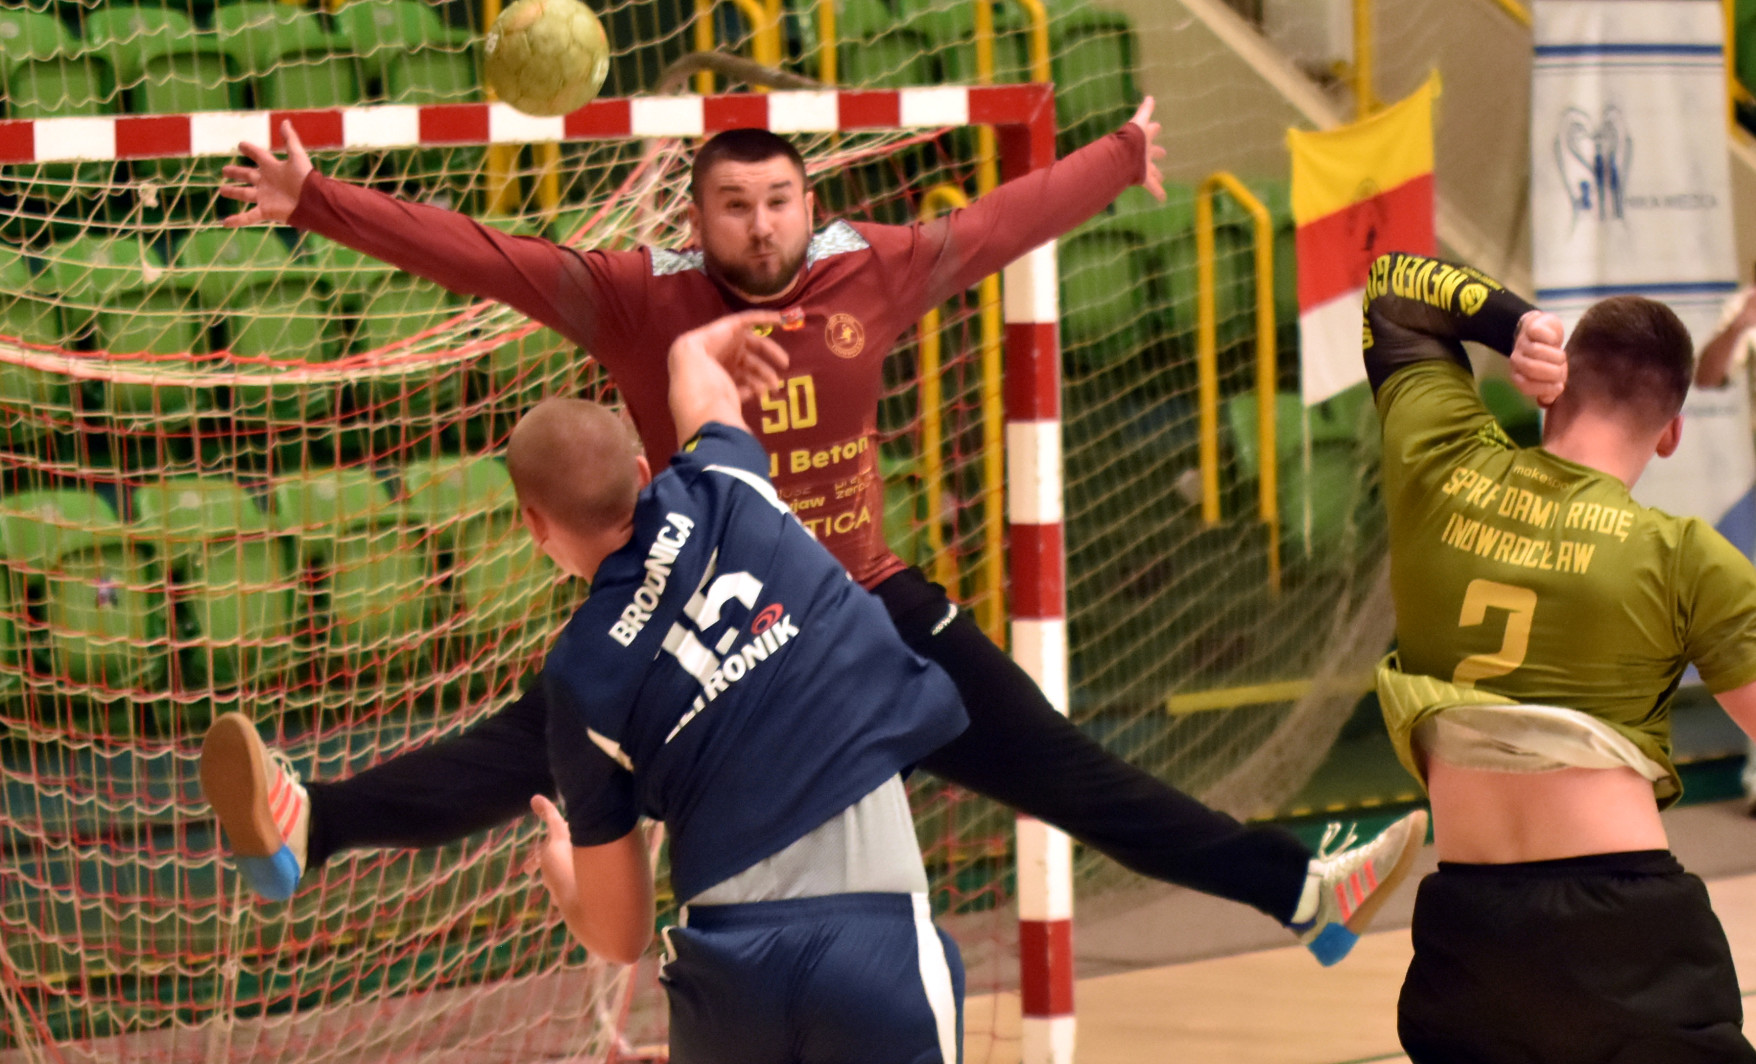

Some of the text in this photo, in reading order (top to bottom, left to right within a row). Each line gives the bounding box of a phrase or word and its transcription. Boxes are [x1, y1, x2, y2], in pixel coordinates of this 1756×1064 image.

[1392, 254, 1469, 312] NEVER
[760, 374, 817, 434] 50
[791, 436, 869, 474] Beton
[800, 505, 871, 537] TICA
[608, 512, 695, 648] BRODNICA
[653, 545, 764, 687] 15
[1452, 578, 1538, 689] 2
